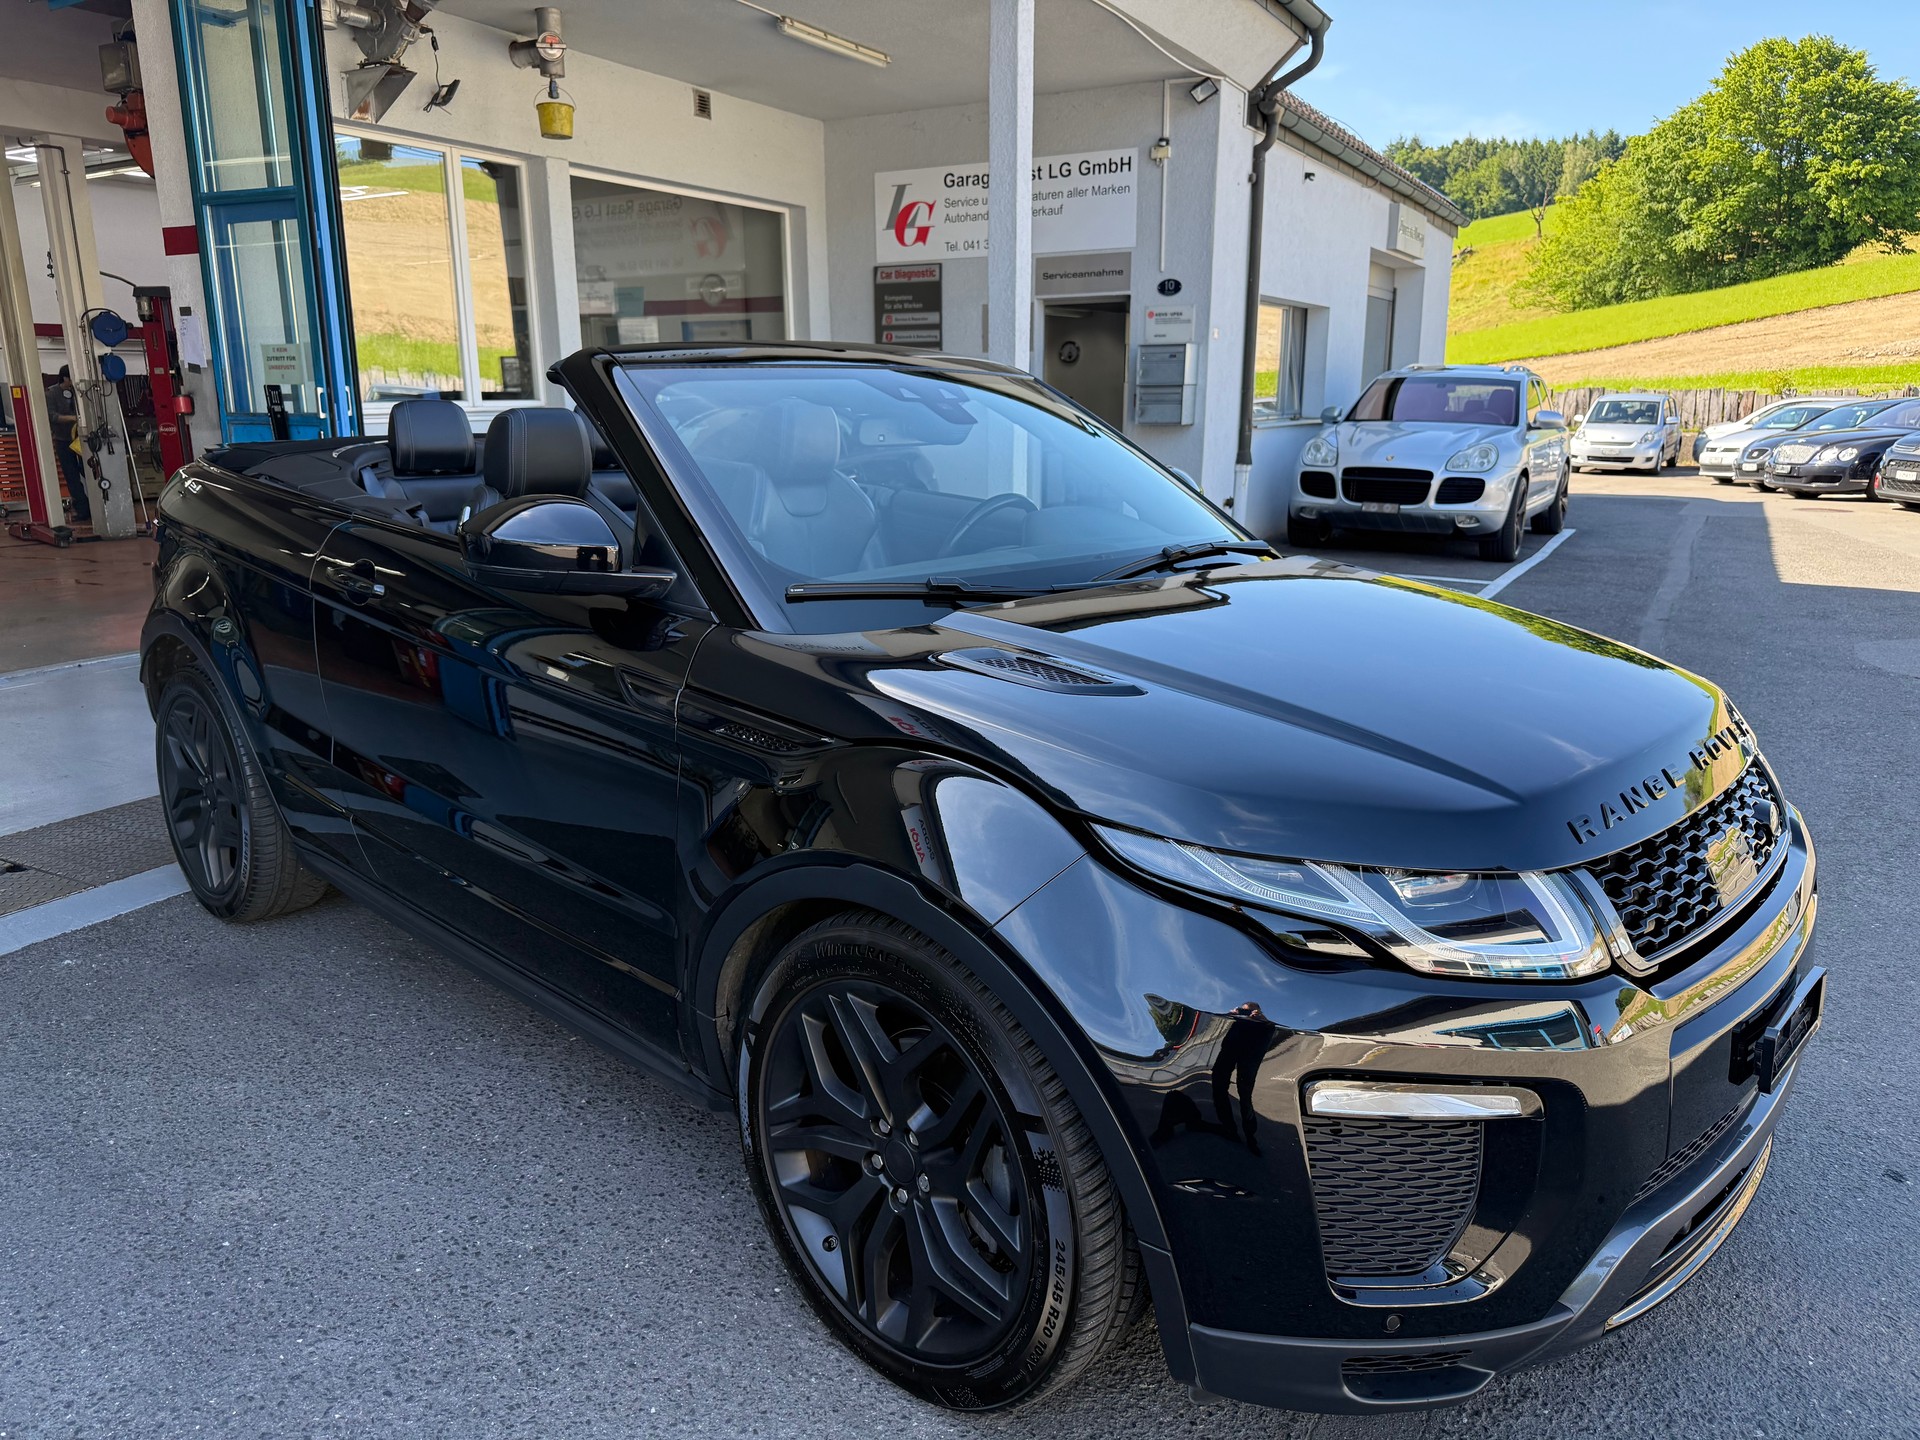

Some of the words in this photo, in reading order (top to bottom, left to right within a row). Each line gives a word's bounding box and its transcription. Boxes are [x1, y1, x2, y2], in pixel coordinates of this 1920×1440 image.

[943, 172, 990, 189] Garag
[1049, 161, 1072, 180] LG
[1078, 156, 1132, 178] GmbH
[943, 197, 980, 209] Service
[1032, 189, 1064, 201] aturen
[1066, 186, 1089, 198] aller
[1091, 184, 1131, 197] Marken
[944, 211, 990, 224] Autohand
[1031, 204, 1064, 217] erkauf
[944, 241, 961, 252] Tel.
[963, 240, 981, 251] 041
[879, 270, 893, 280] Car
[895, 267, 937, 281] Diagnostic
[1042, 267, 1124, 281] Serviceannahme
[1164, 279, 1175, 291] 10
[1566, 763, 1687, 845] RANGE
[1052, 1239, 1065, 1305] 245/45
[1042, 1305, 1061, 1339] R20
